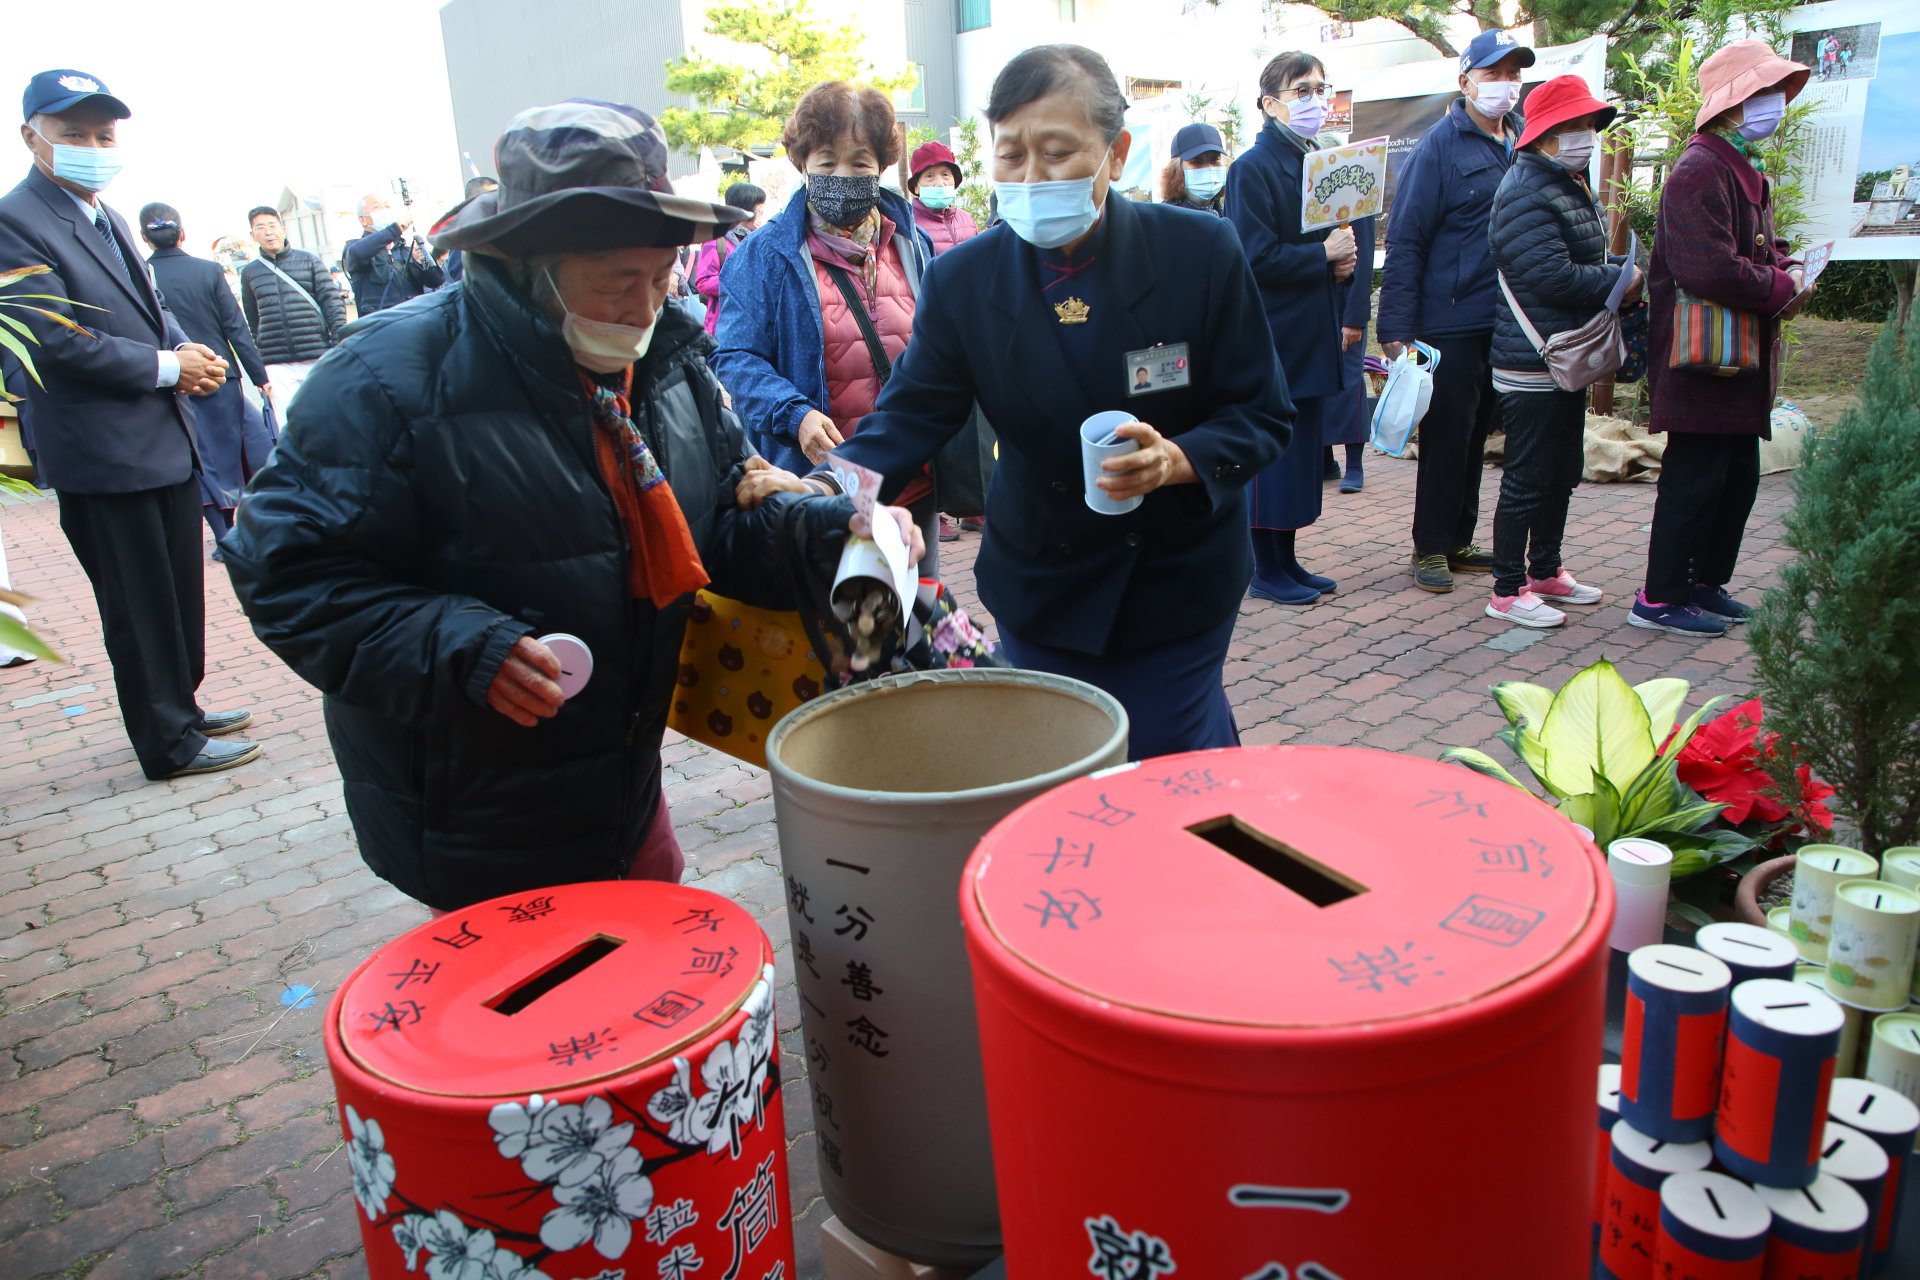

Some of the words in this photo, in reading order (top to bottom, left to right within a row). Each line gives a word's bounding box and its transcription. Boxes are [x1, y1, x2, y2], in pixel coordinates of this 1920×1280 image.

[1314, 164, 1376, 205] 請跟我來
[786, 874, 845, 1180] 就是一分祝福
[825, 857, 890, 1059] 一分善念
[706, 1042, 785, 1280] 竹筒
[1228, 1184, 1350, 1280] 一
